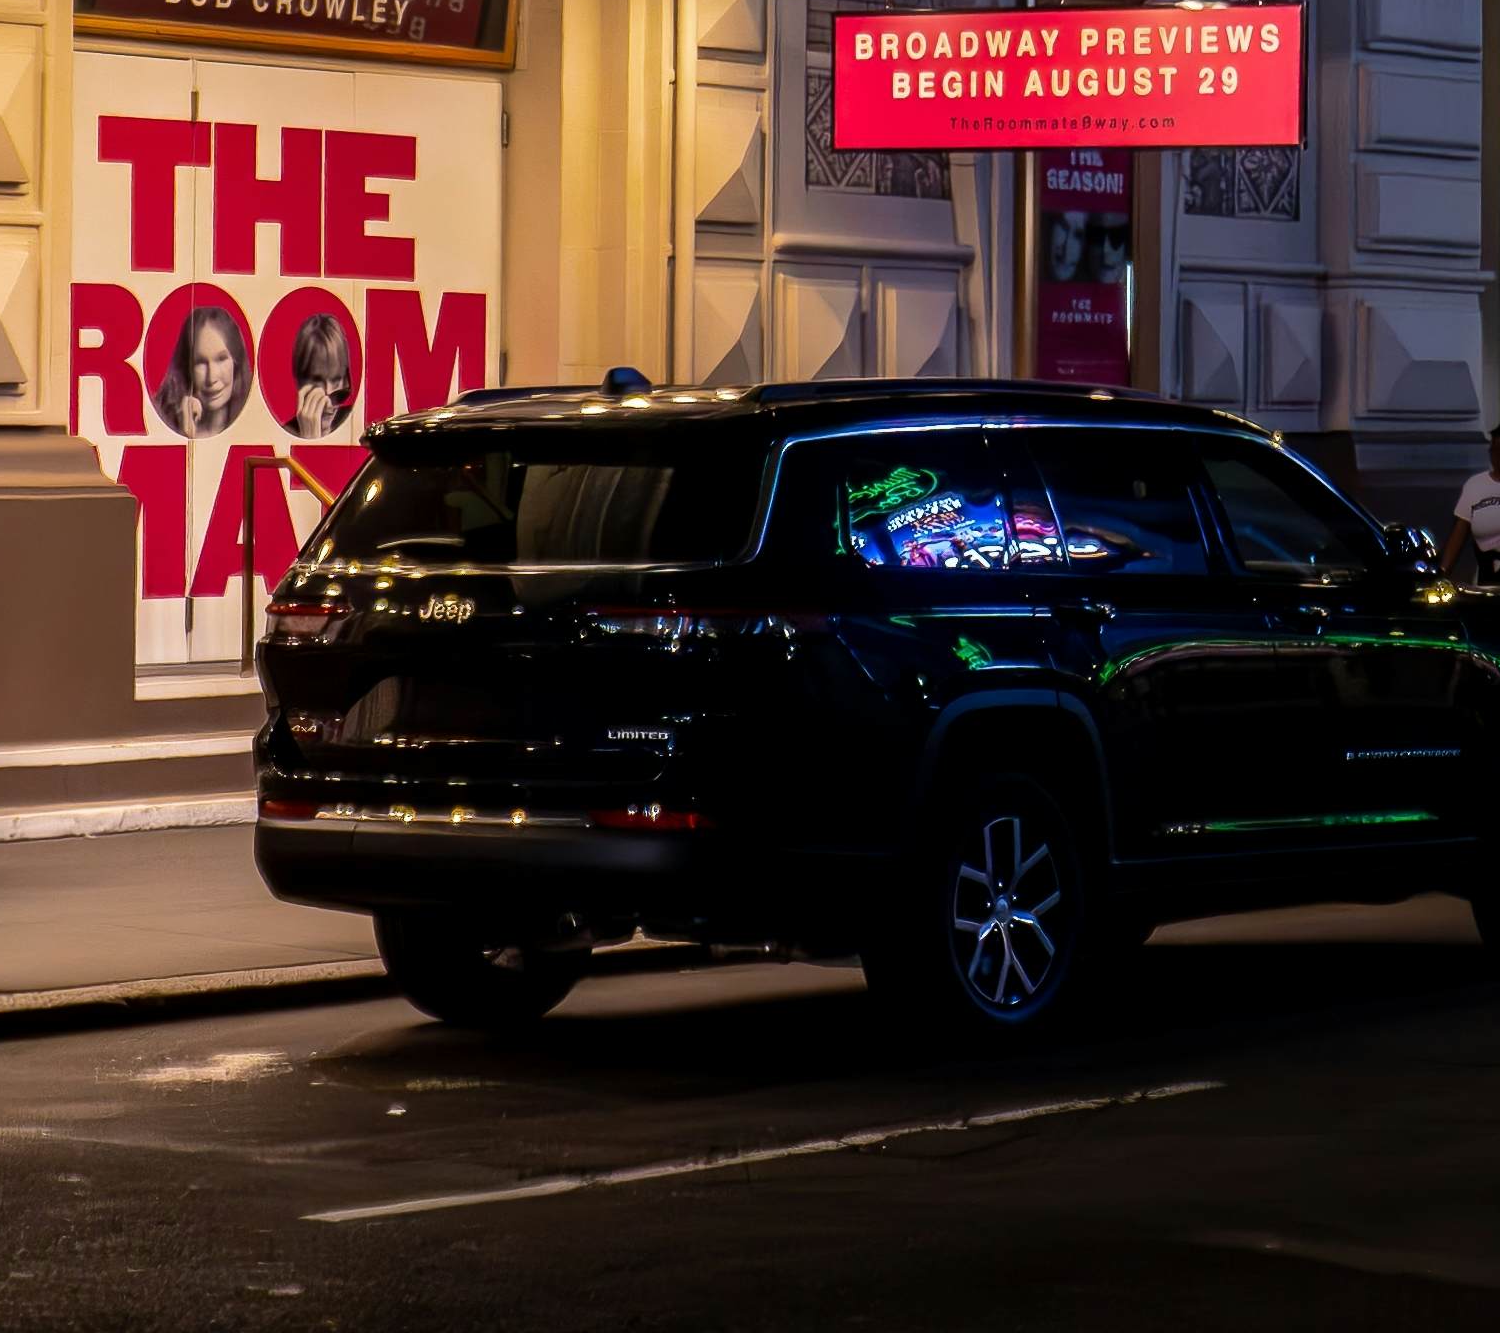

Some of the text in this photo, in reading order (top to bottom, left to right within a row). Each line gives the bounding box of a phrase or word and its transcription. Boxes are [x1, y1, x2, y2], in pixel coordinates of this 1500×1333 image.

[854, 22, 1282, 62] BROADWAY PREVIEWS
[891, 65, 1241, 100] BEGIN AUGUST 29
[950, 114, 1177, 133] TheRoommateBway.com
[1046, 169, 1124, 195] SEASON!
[97, 114, 418, 282] THE
[69, 281, 488, 440] ROOM
[419, 597, 476, 625] Jeep
[606, 729, 670, 741] LIMITED
